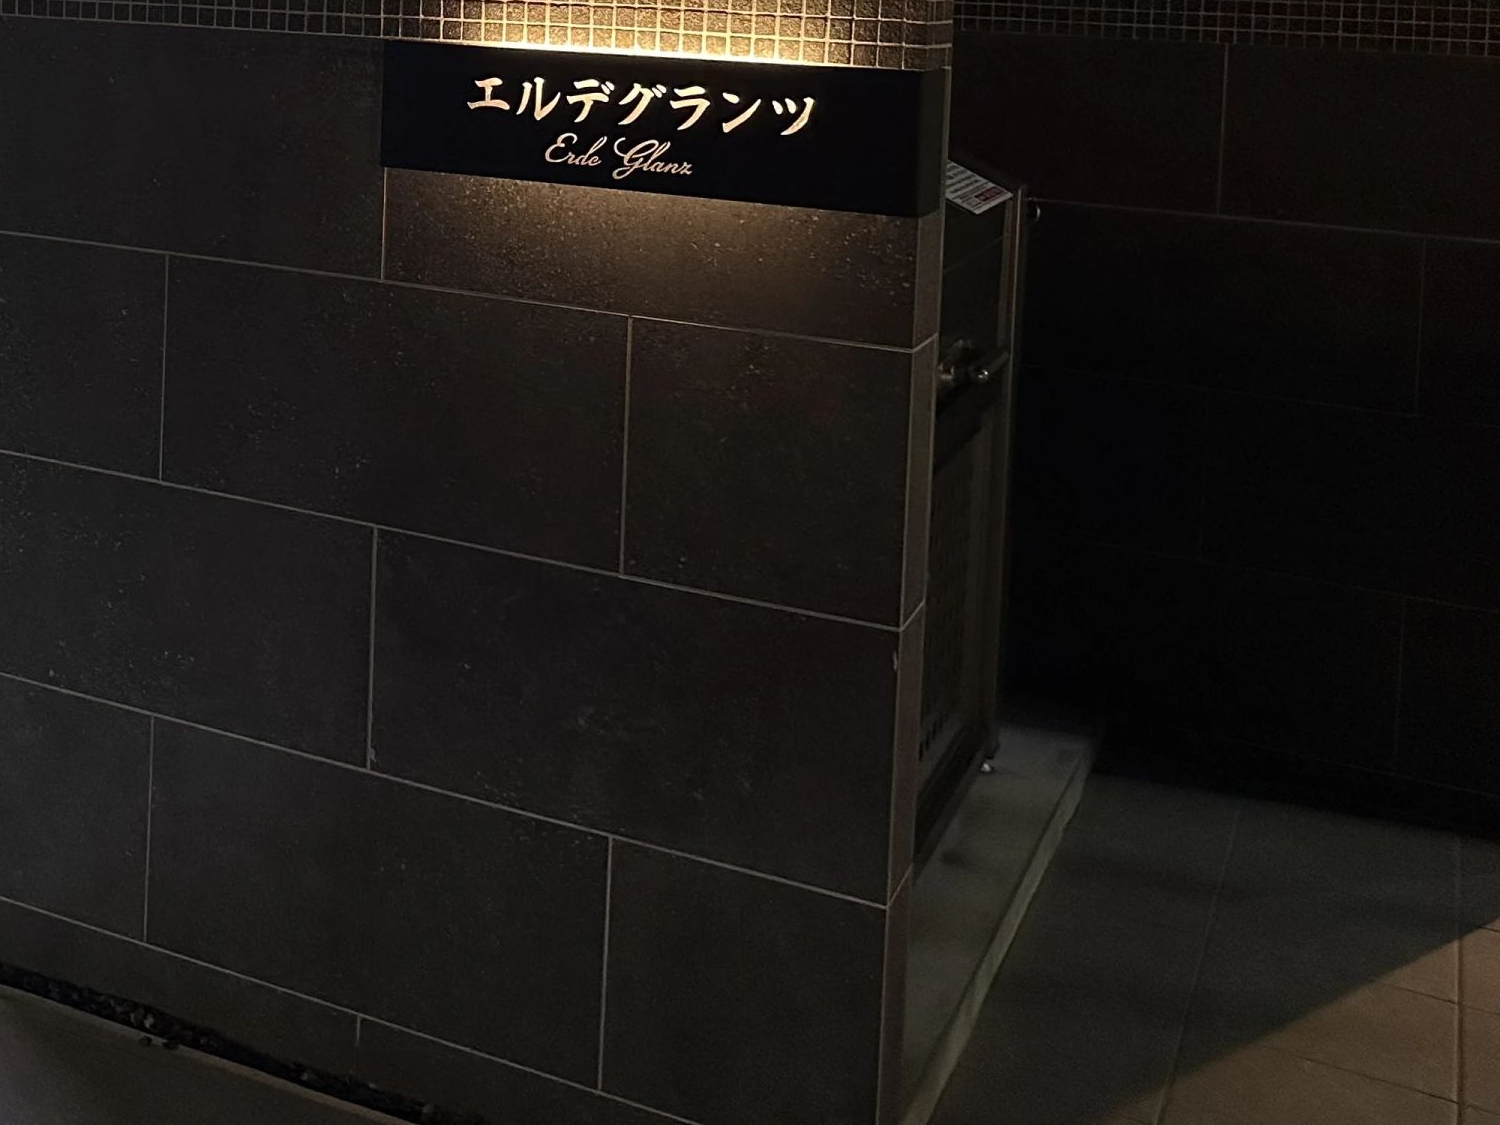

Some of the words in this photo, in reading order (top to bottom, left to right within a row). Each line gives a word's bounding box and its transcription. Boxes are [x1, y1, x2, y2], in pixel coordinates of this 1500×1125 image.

[466, 75, 816, 137] エルデグランツ
[544, 132, 608, 168] Erde
[612, 137, 693, 180] Glanz
